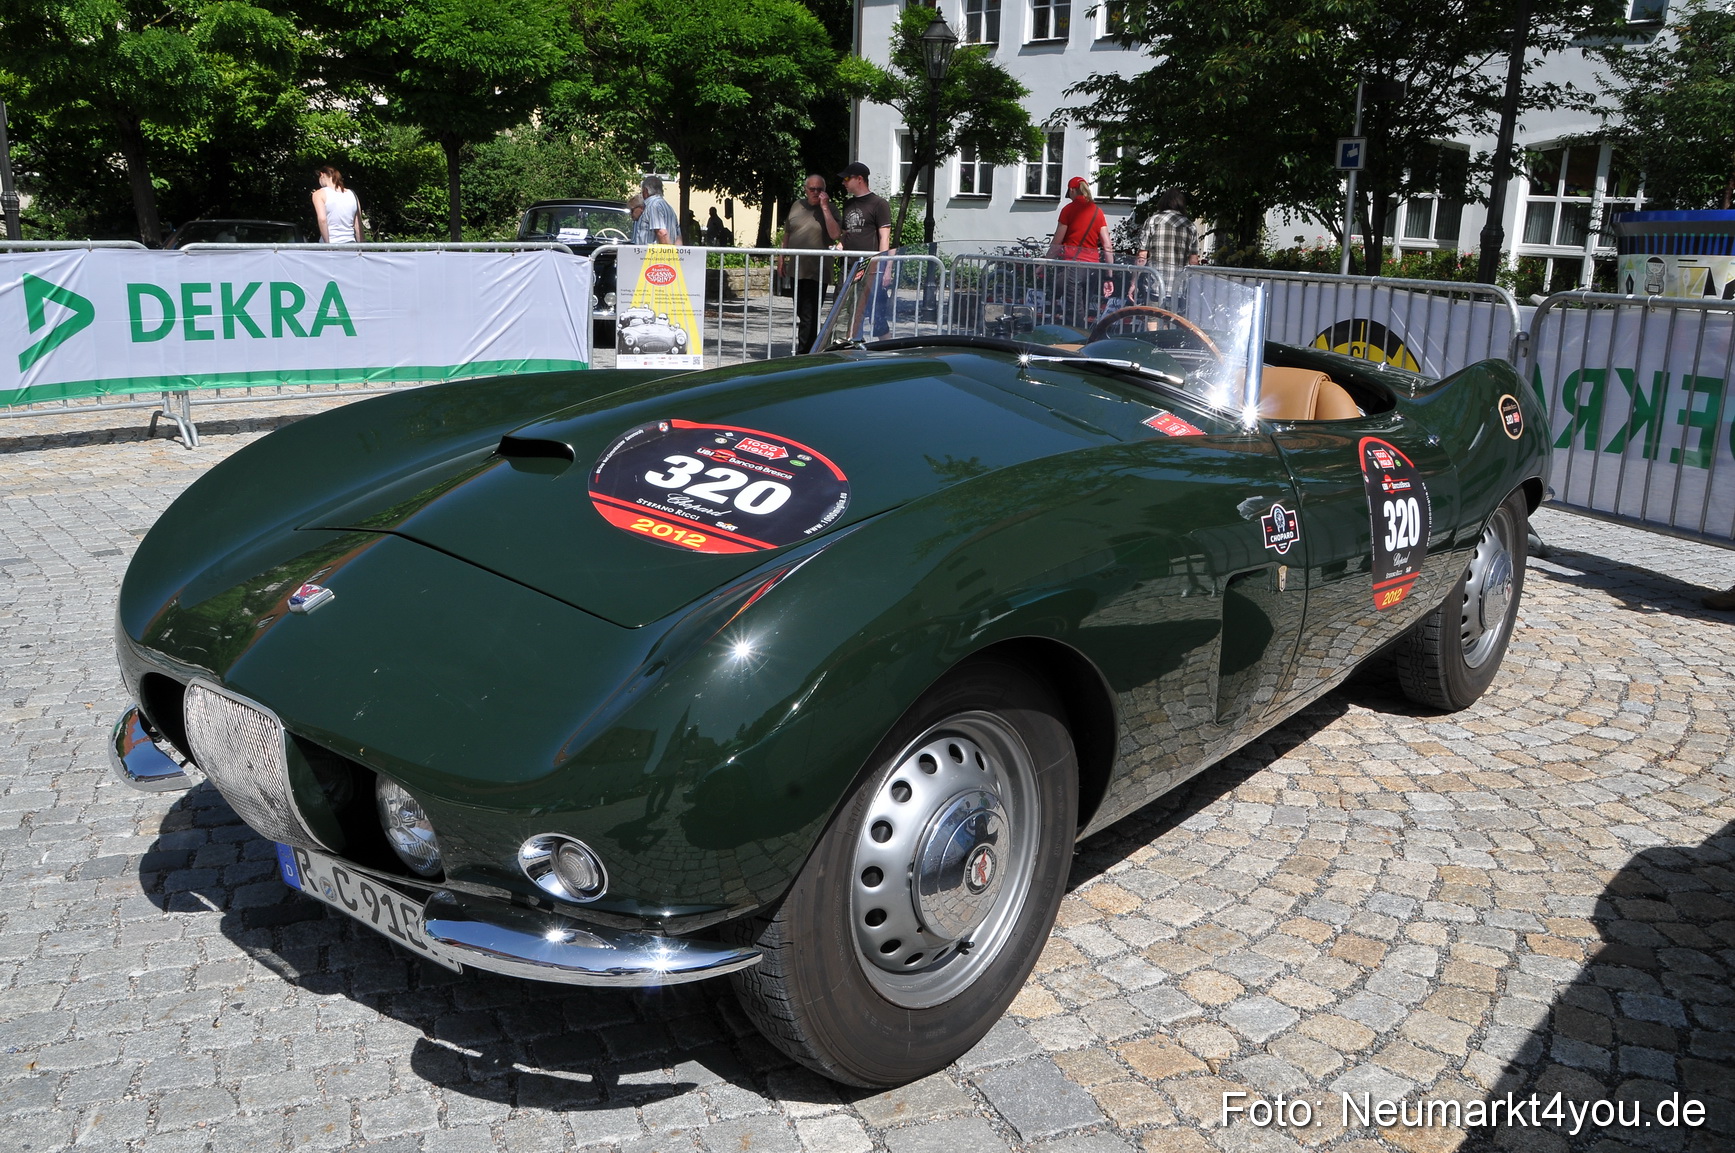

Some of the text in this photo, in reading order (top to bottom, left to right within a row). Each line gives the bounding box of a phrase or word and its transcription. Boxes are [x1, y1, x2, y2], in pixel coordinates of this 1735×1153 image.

[675, 248, 691, 256] 2014
[127, 281, 357, 343] DEKRA
[739, 444, 775, 458] MIGLIA
[747, 440, 778, 452] 1000
[697, 448, 715, 457] UBI
[728, 457, 754, 470] Banco
[754, 464, 763, 472] di
[763, 467, 793, 480] Brescia
[644, 455, 792, 515] 320
[636, 498, 700, 521] STEFANO RICCI
[667, 492, 732, 517] Chopard
[630, 518, 707, 548] 2012
[1383, 497, 1420, 552] 320
[1270, 531, 1294, 543] CHOPARD
[1381, 588, 1403, 606] 2012
[285, 864, 293, 878] D
[293, 849, 319, 893] R
[332, 866, 358, 912] C
